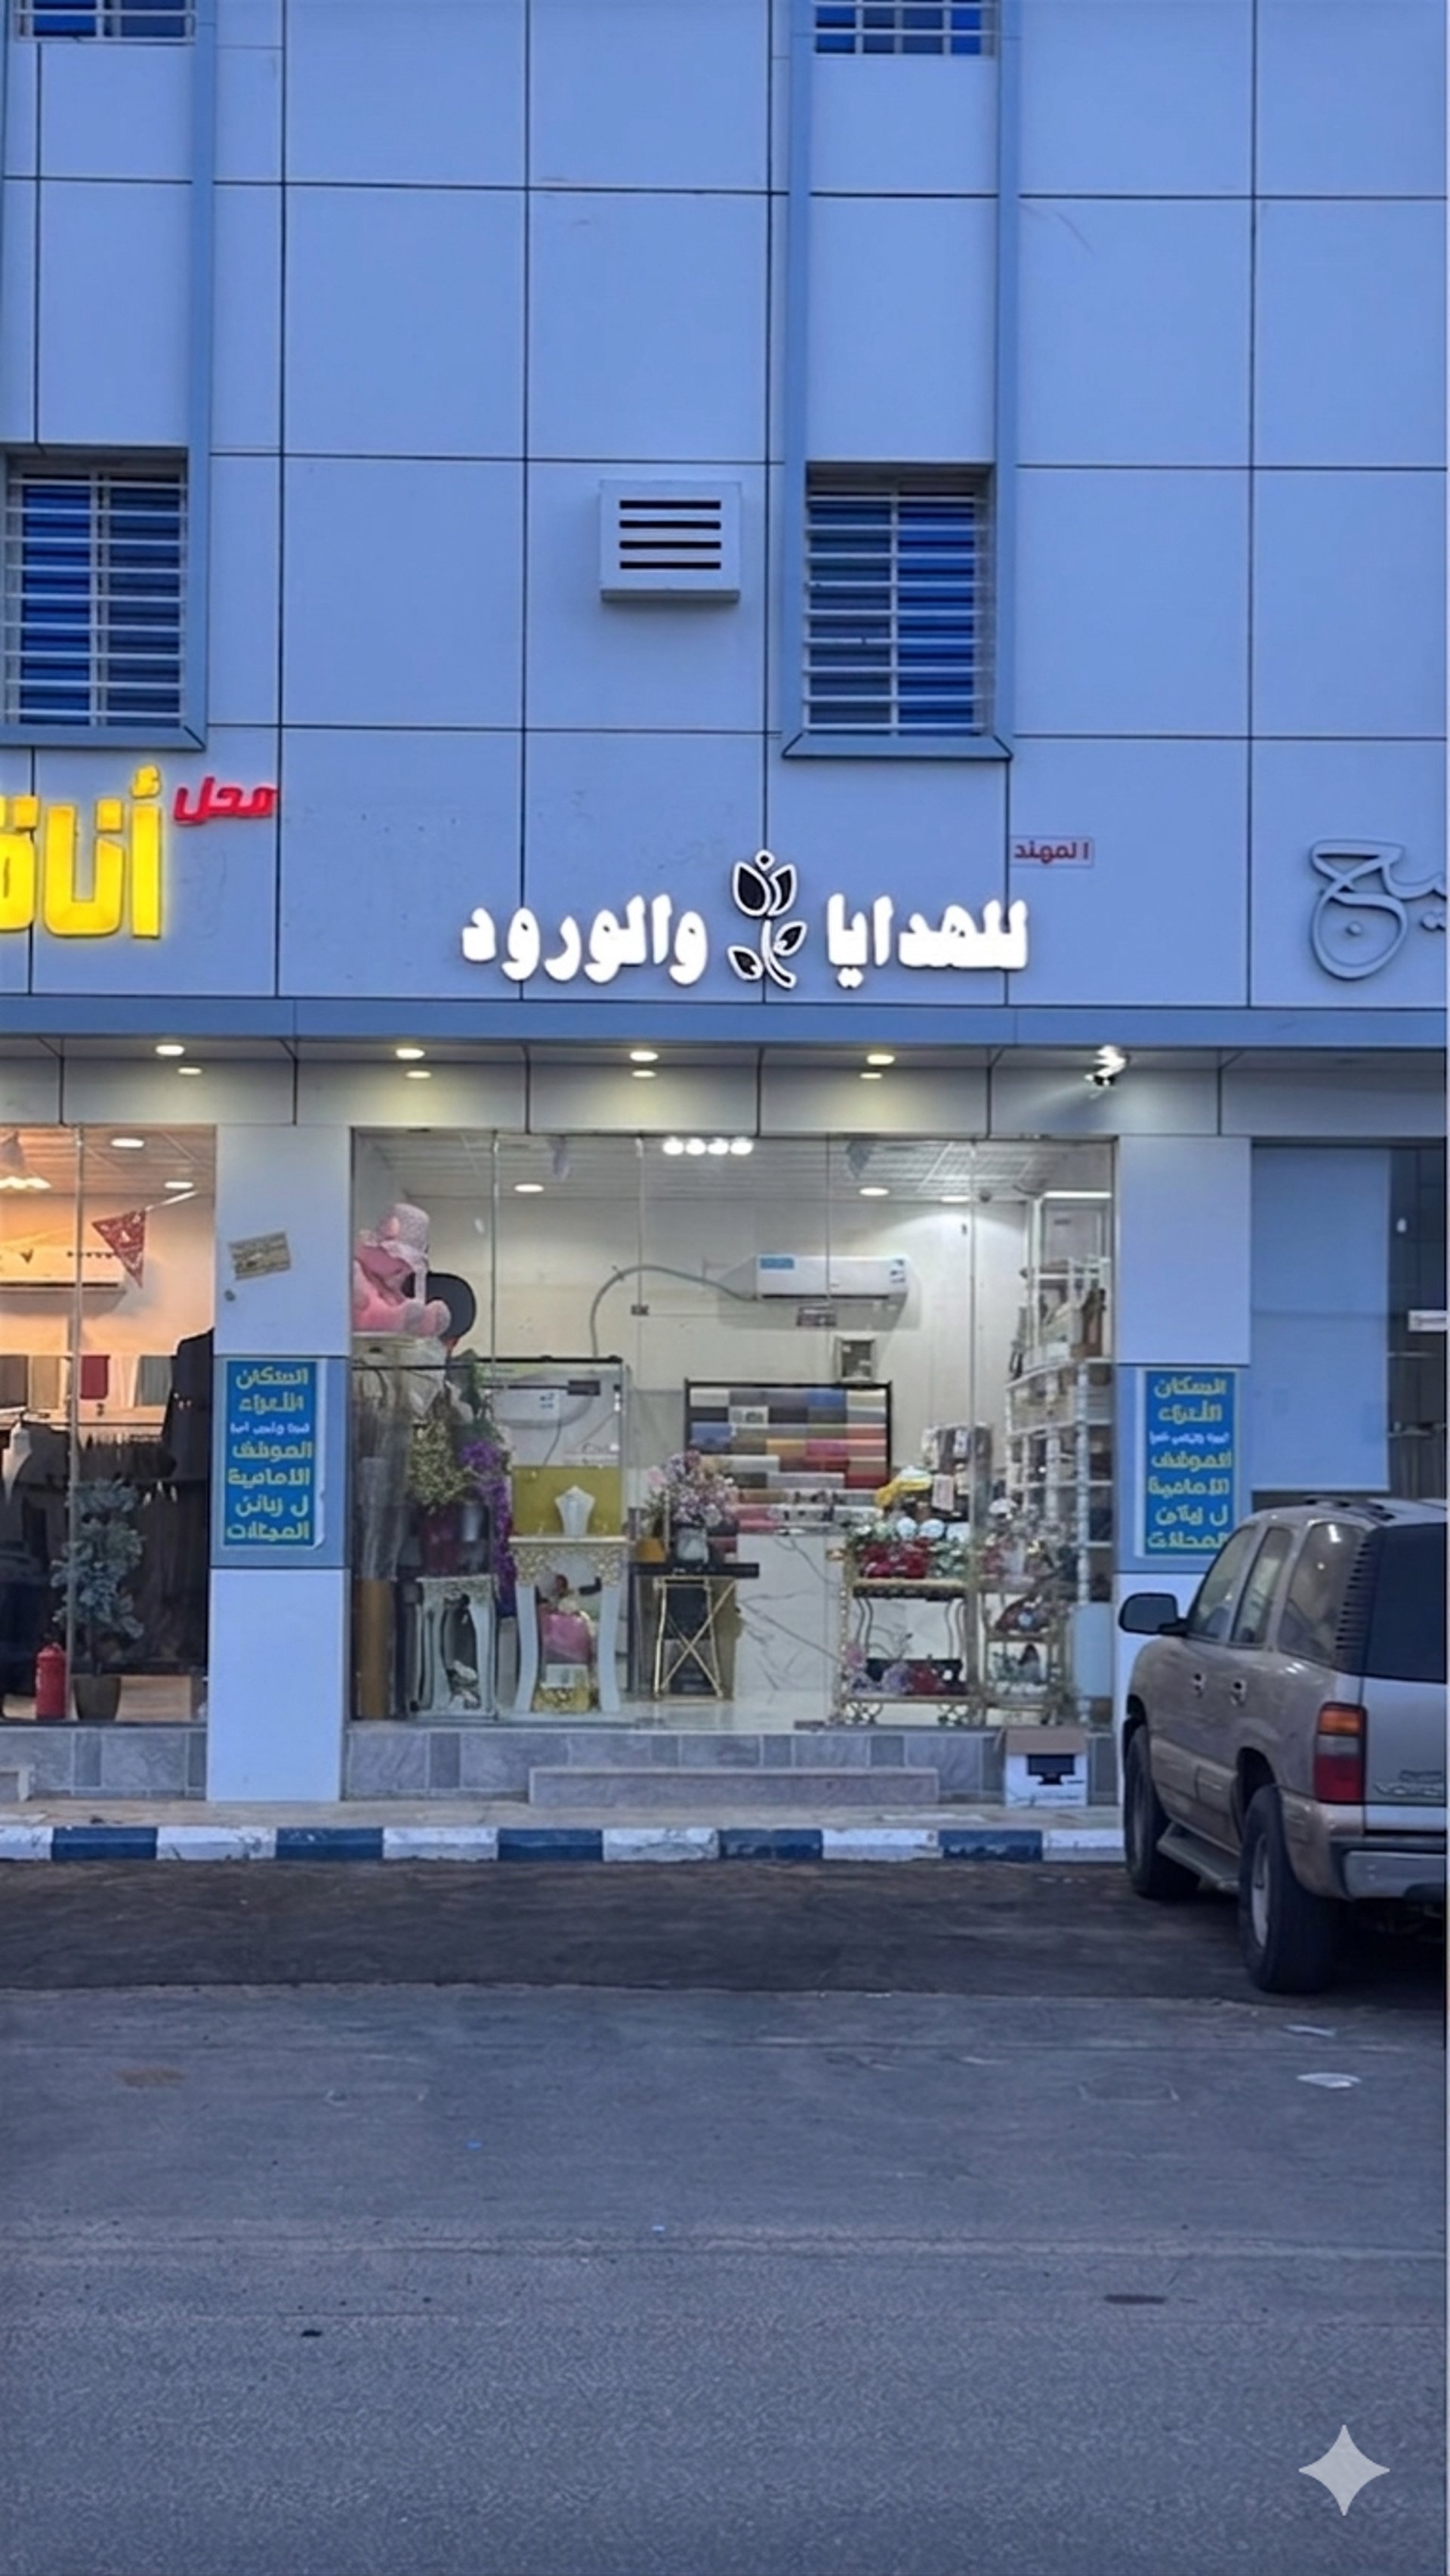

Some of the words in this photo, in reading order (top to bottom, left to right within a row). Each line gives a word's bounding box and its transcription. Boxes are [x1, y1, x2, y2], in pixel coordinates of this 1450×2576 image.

[173, 776, 278, 825] محل
[461, 894, 708, 985] والورود
[828, 894, 1028, 988] للهدايا
